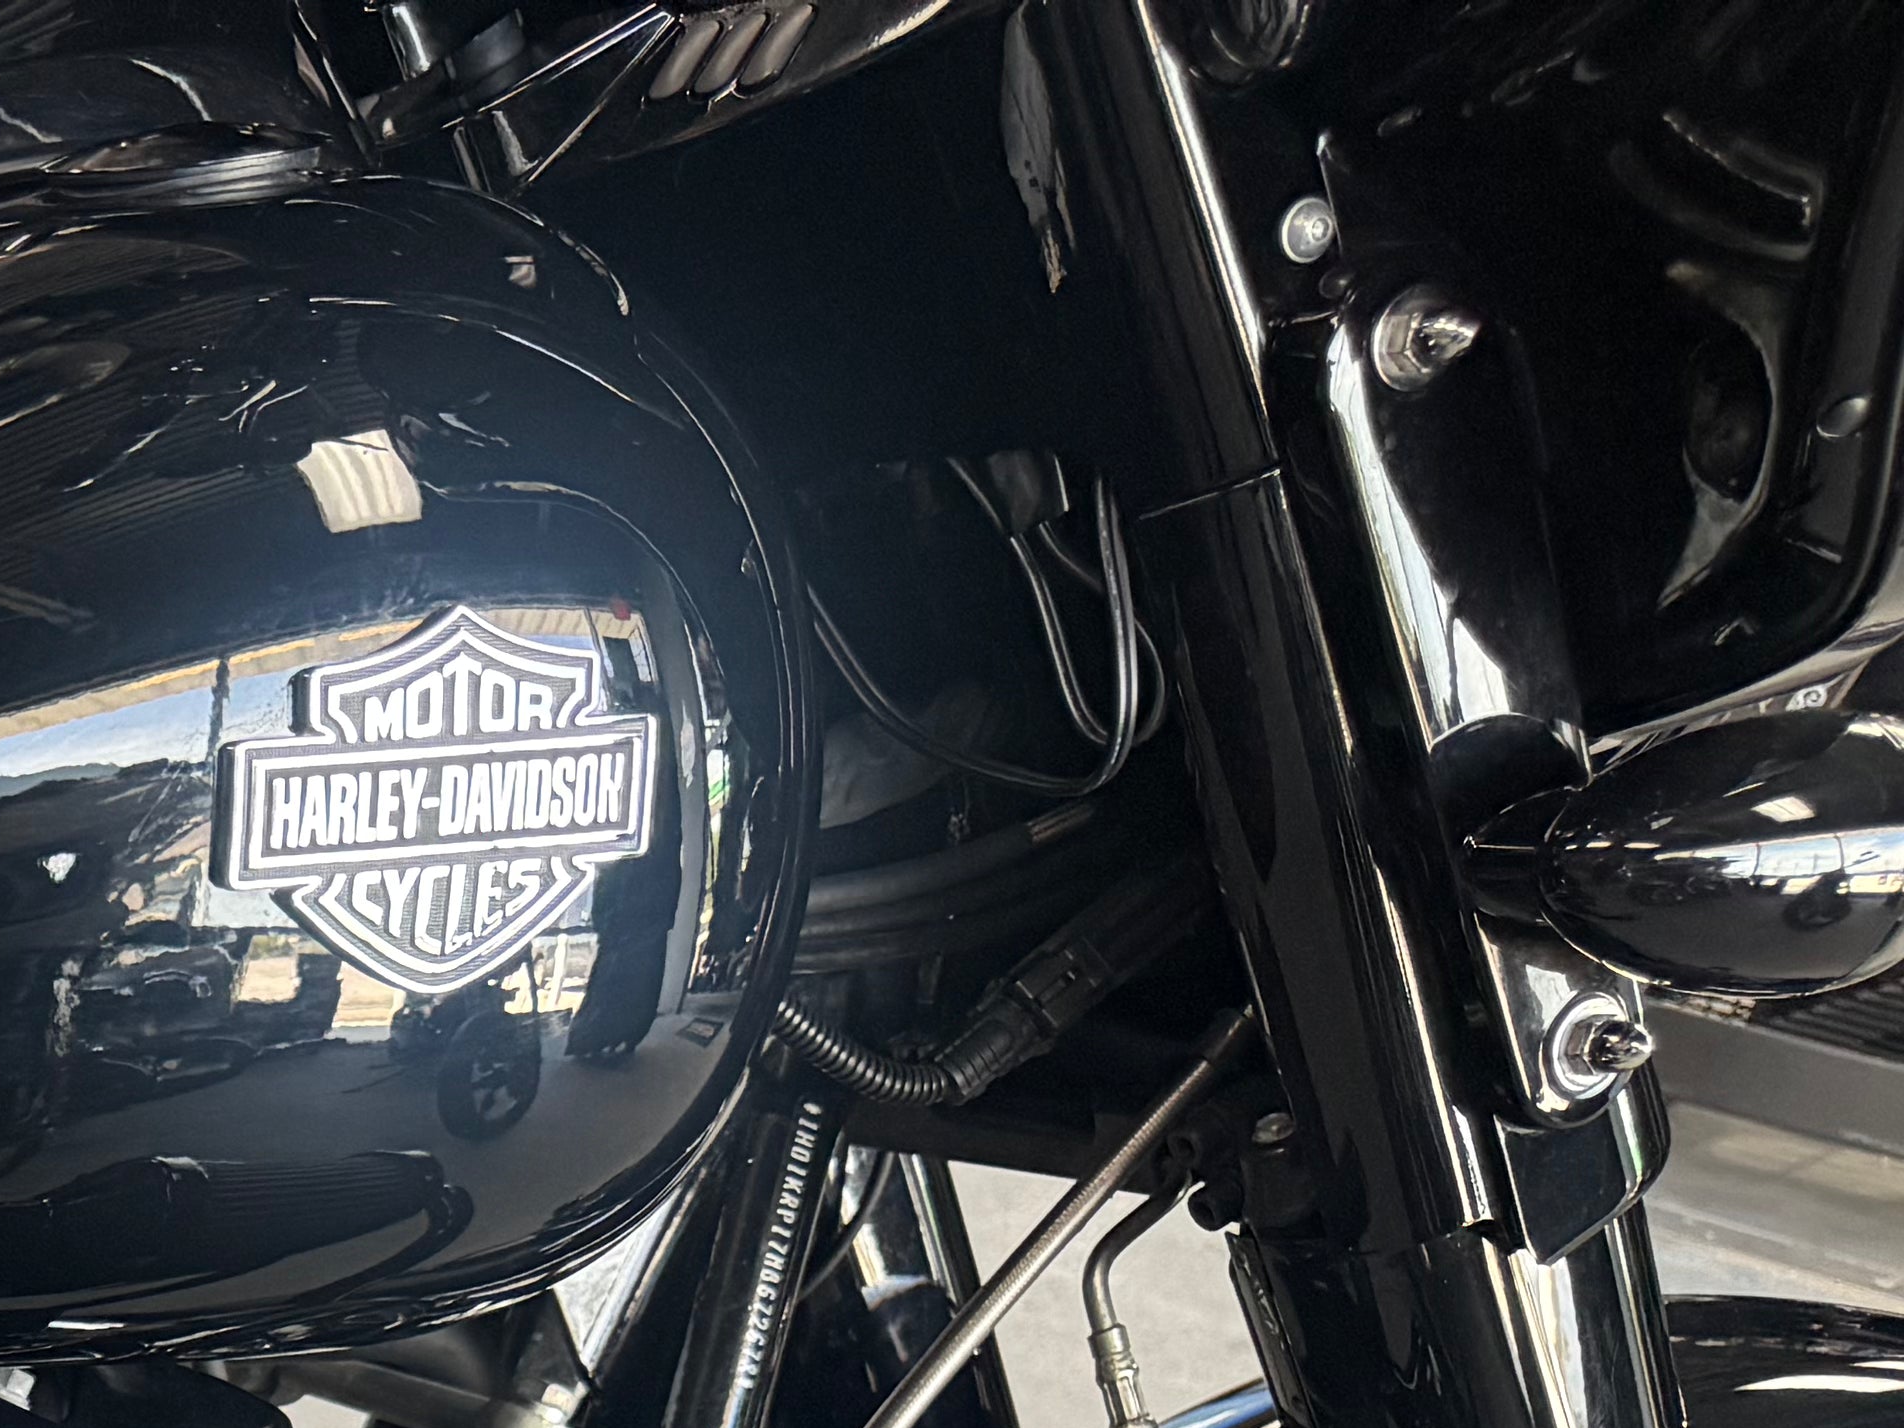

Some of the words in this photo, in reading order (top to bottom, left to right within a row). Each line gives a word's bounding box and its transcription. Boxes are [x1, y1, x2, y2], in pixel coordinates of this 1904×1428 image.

[363, 651, 554, 743] MOTOR
[269, 751, 626, 850] HARLEY-DAVIDSON
[351, 857, 544, 956] CYCLES
